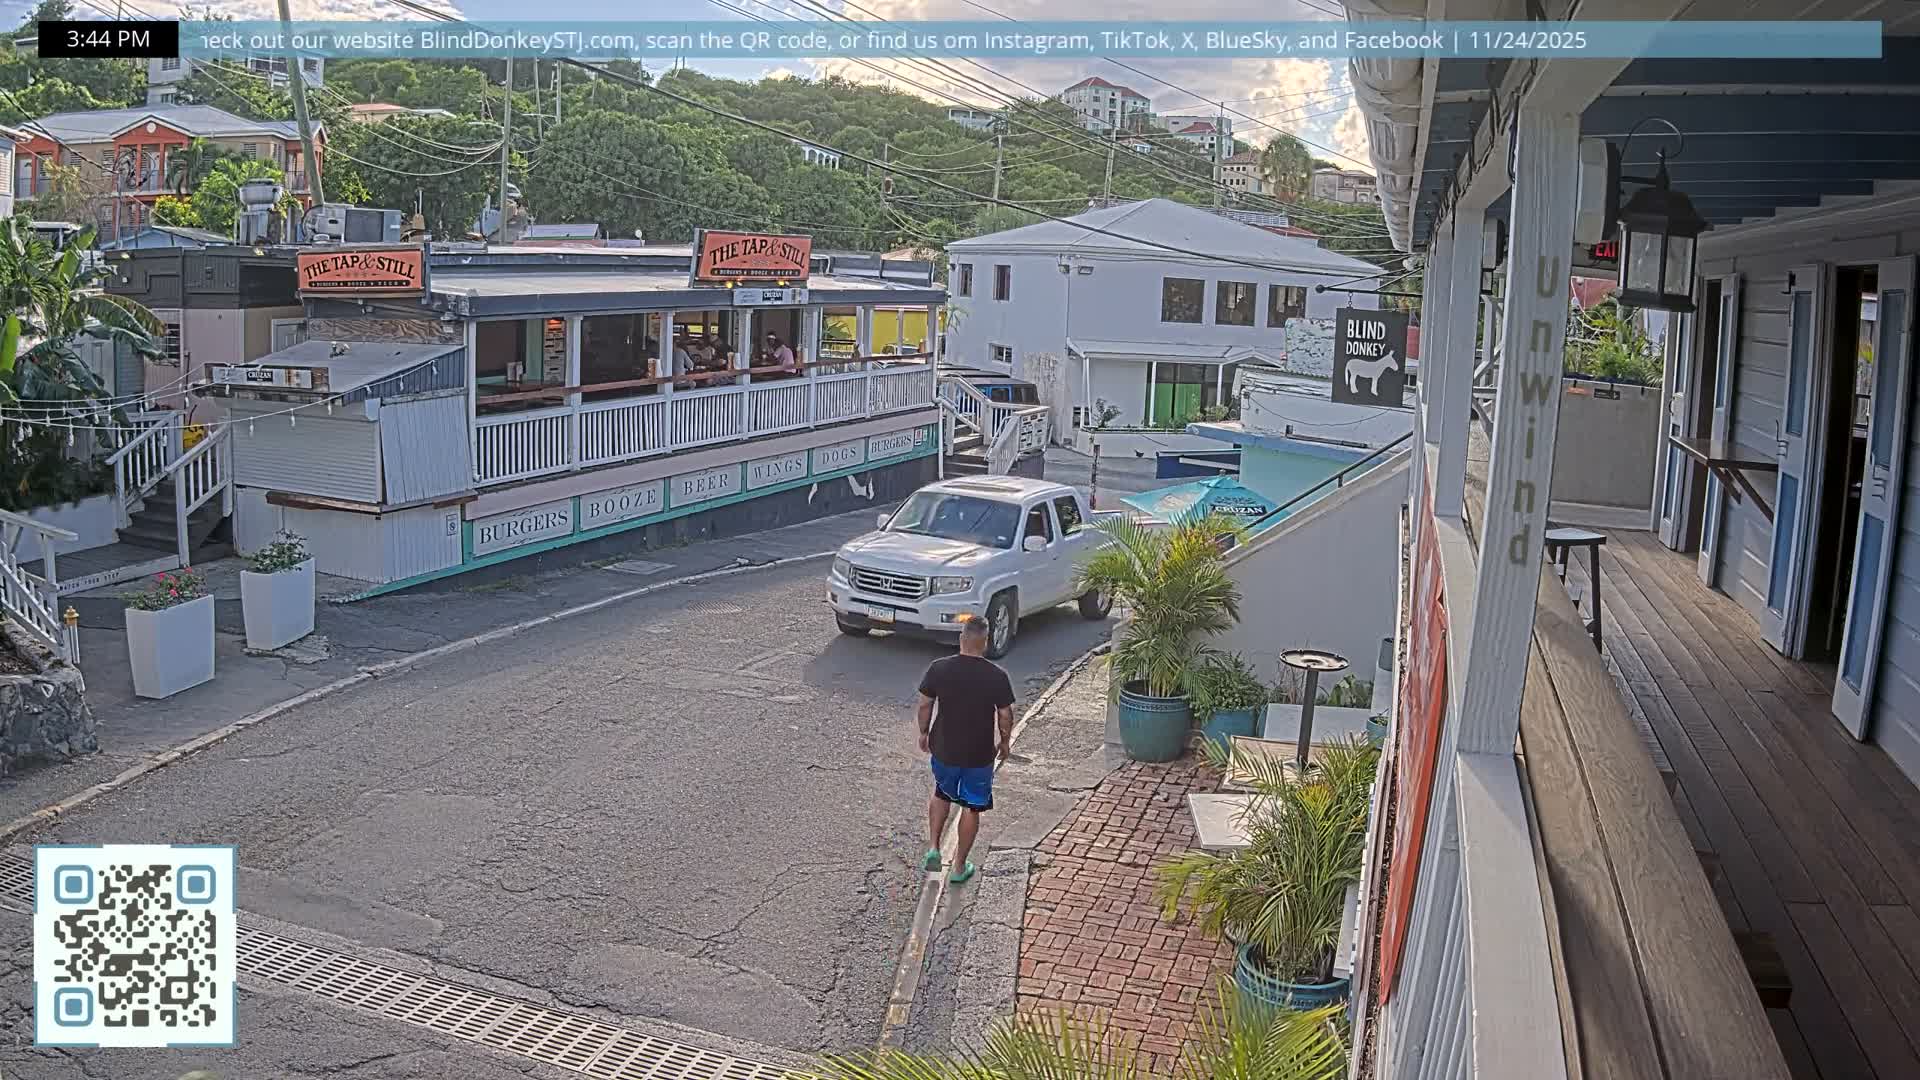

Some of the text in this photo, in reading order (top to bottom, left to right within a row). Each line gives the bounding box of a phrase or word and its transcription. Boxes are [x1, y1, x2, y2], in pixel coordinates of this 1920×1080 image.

[710, 238, 806, 269] THE TAP & STILL
[1595, 242, 1616, 258] EXI
[304, 253, 415, 280] THE TAP & STILL
[1346, 319, 1386, 340] BLIND
[1345, 341, 1386, 357] DONKEY
[871, 433, 912, 454] BURGERS
[822, 447, 857, 465] DOGS
[753, 458, 802, 480] WINGS
[683, 473, 729, 496] BEER
[590, 489, 656, 519] BOOZE
[1214, 505, 1264, 514] CRUZAN
[479, 510, 569, 545] BURGERS
